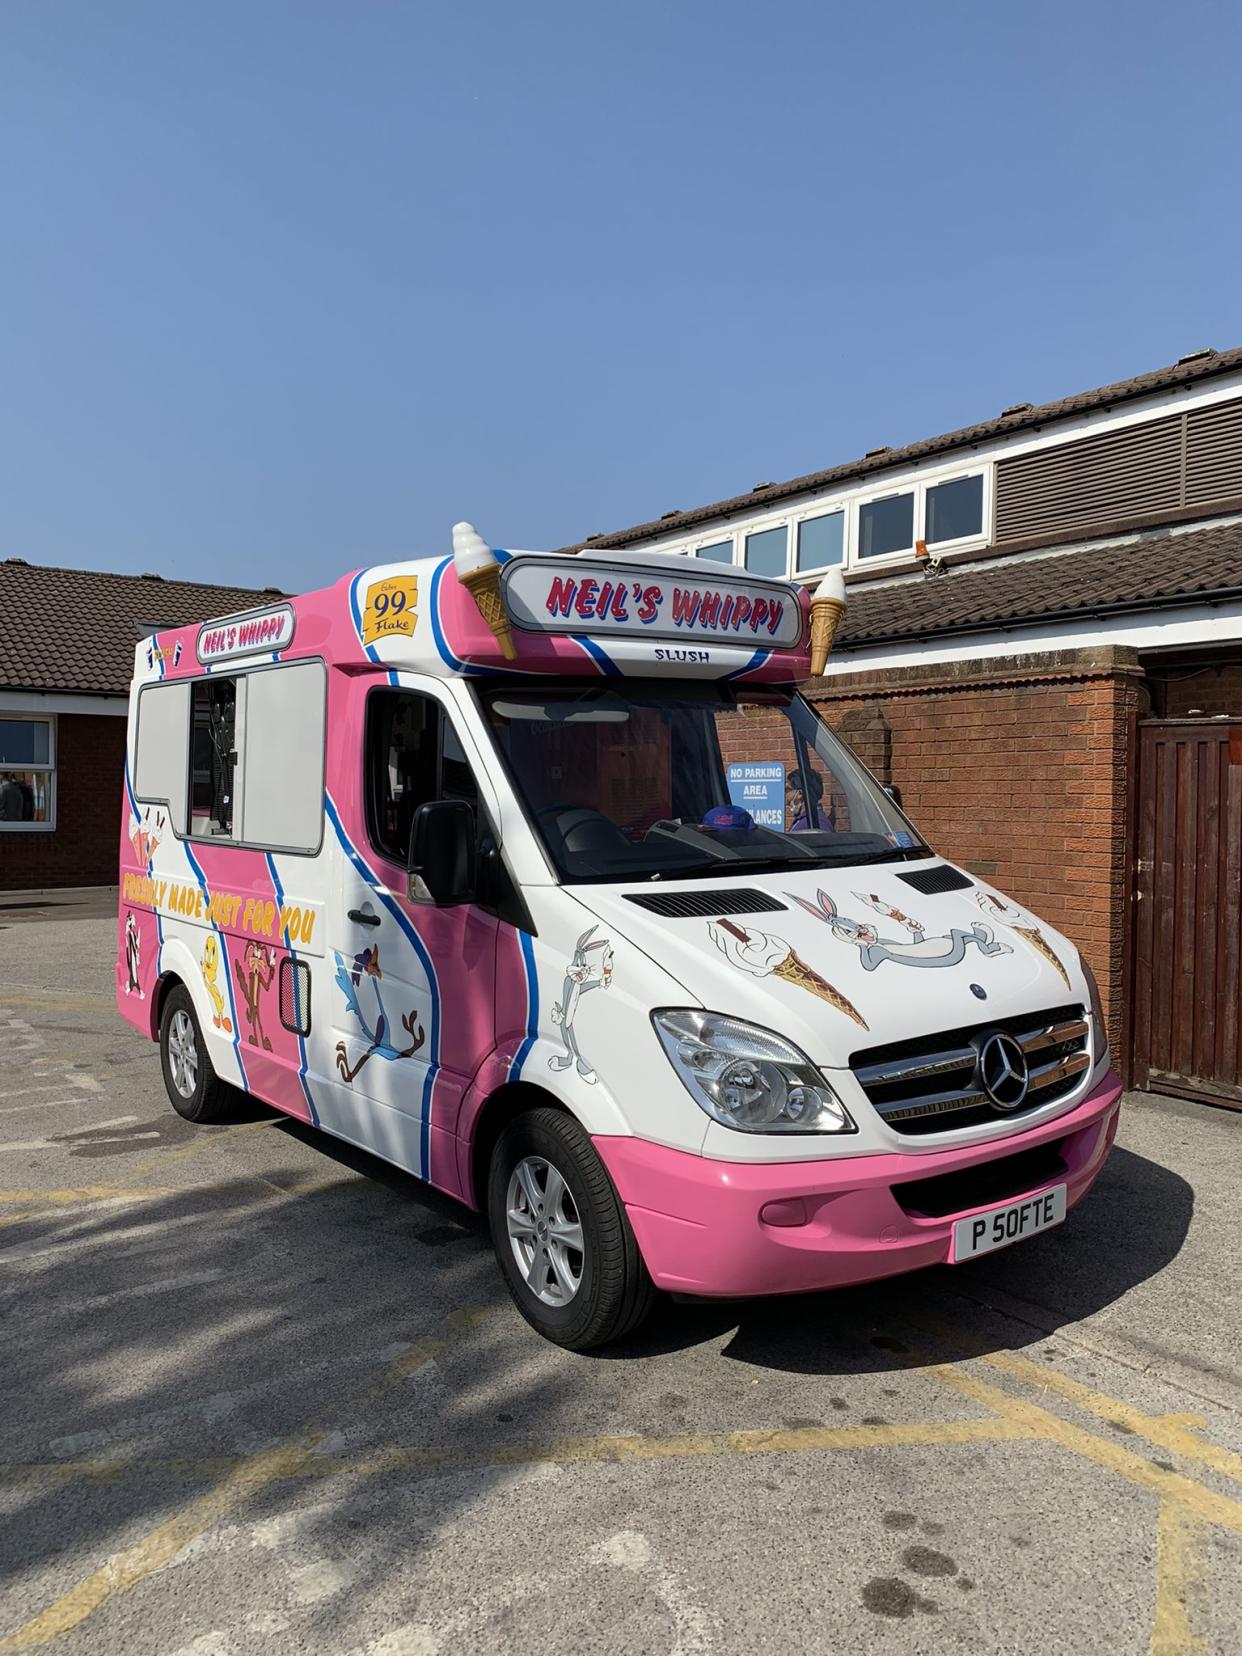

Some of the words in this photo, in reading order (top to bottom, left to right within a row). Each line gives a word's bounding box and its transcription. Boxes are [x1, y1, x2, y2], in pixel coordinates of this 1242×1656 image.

[374, 590, 406, 618] 99
[546, 577, 663, 624] NEIL'S
[672, 588, 784, 635] WHIPPY
[203, 627, 236, 654] NEIL'S
[239, 615, 285, 647] WHIPPY
[375, 617, 409, 633] Flake
[655, 649, 709, 663] SLUSH
[730, 768, 743, 778] NO
[745, 768, 782, 778] PARKING
[743, 785, 768, 795] AREA
[168, 883, 203, 918] MADE
[205, 891, 242, 928] JUST
[242, 898, 276, 936] FOR
[280, 904, 315, 944] YOU
[972, 1219, 986, 1250] P
